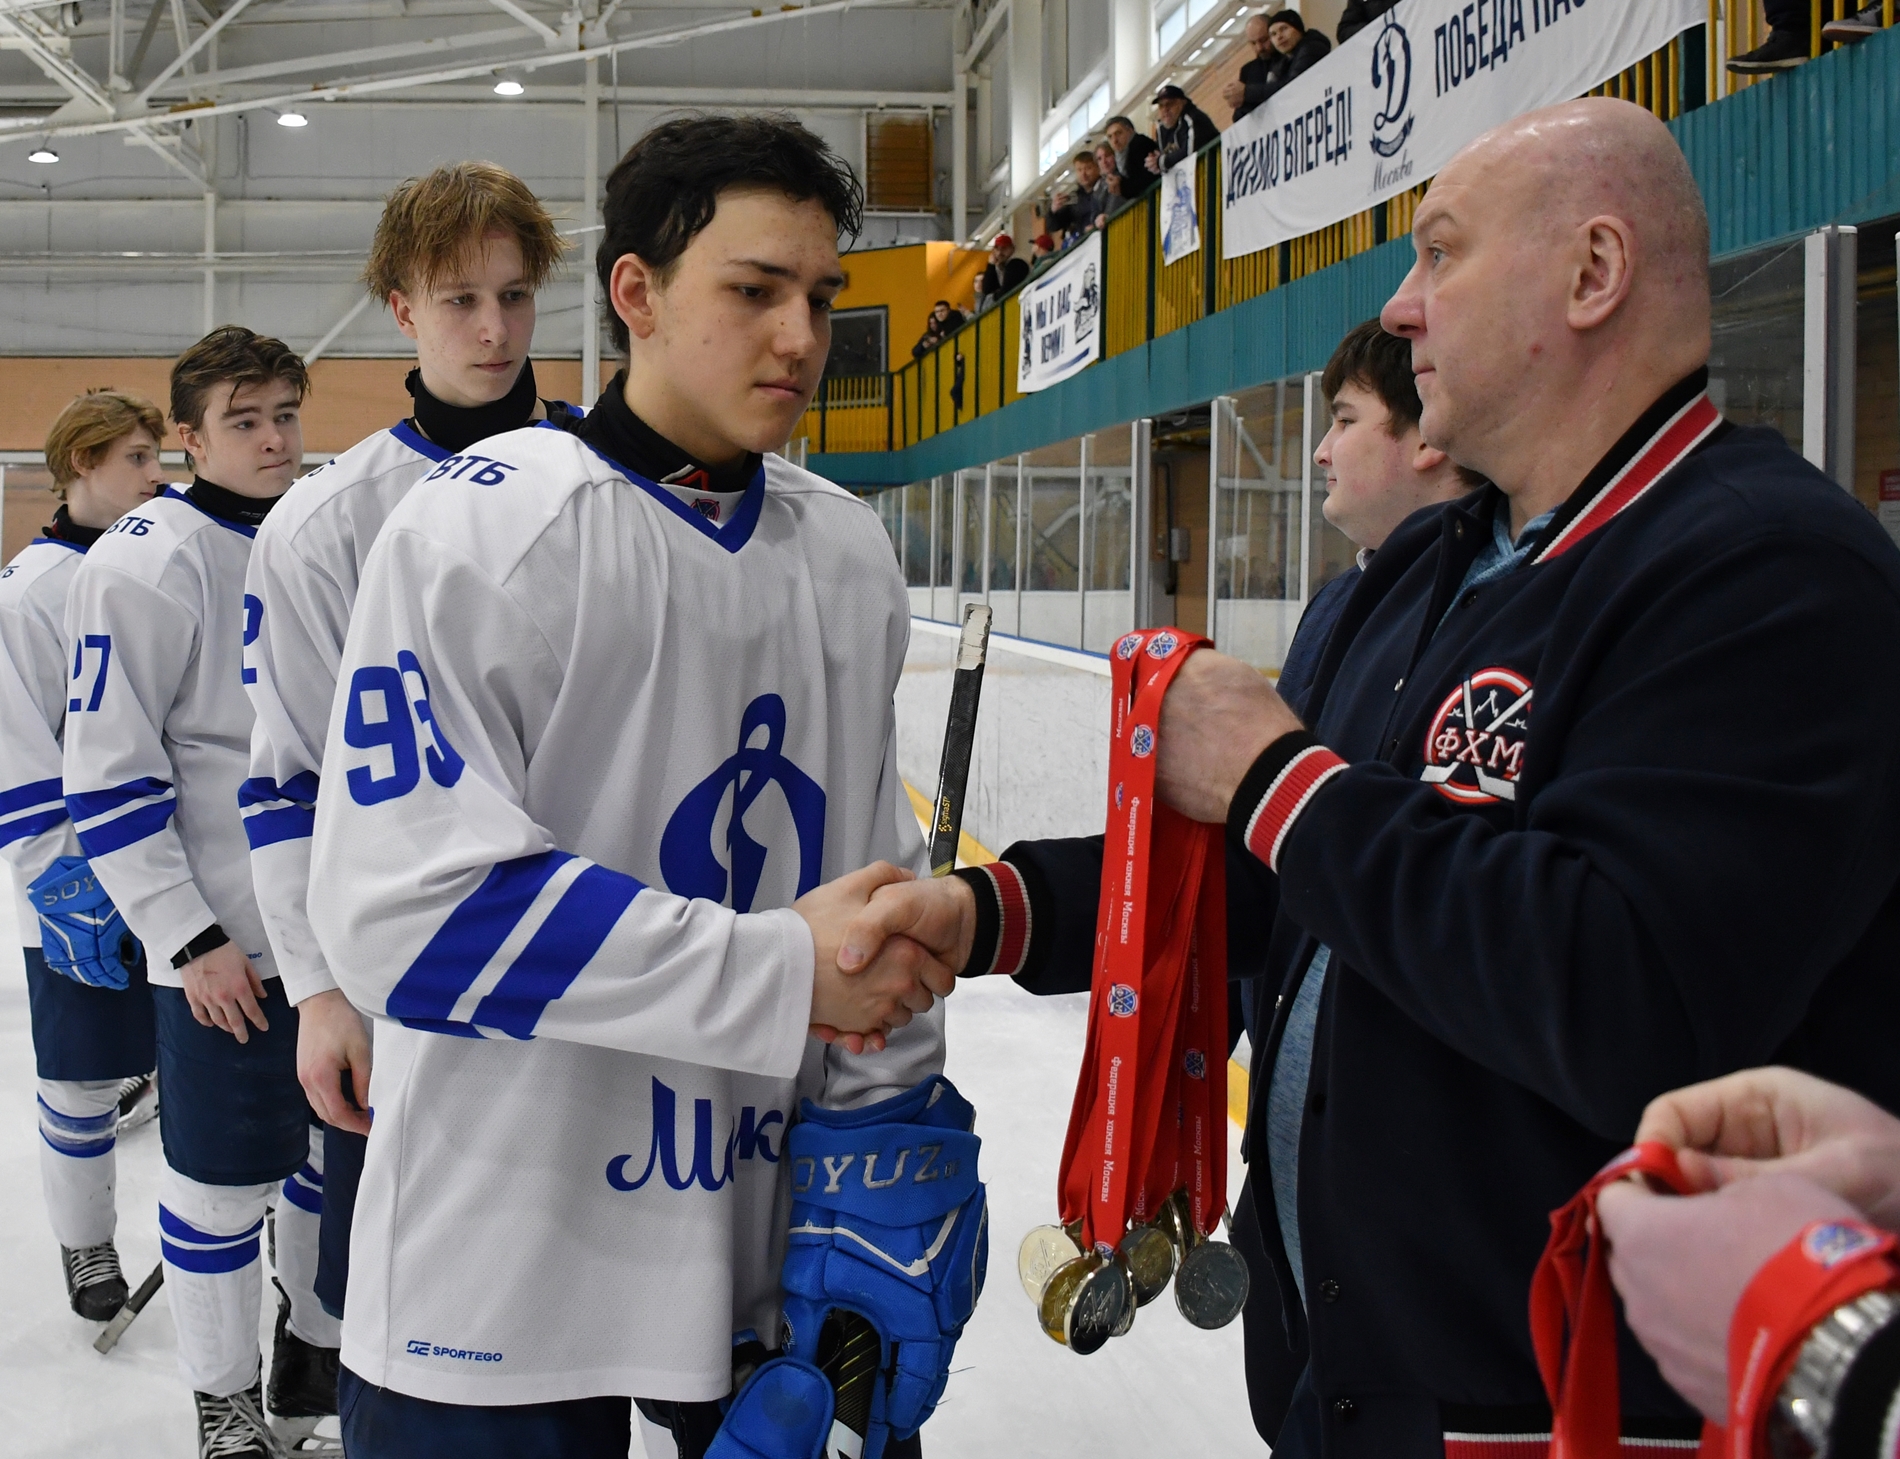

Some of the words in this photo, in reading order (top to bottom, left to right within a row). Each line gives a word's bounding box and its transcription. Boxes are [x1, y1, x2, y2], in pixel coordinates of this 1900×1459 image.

[1434, 0, 1525, 98] ПОБЕДА
[1283, 86, 1353, 183] ВПЕРЁД!
[423, 455, 519, 486] ВТБ
[1435, 726, 1526, 774] ФХМ
[1128, 796, 1140, 856] Федерация
[44, 874, 96, 906] SOY
[1124, 860, 1133, 896] хоккея
[1120, 901, 1133, 944] Москвы
[1107, 1056, 1122, 1115] Федерация
[1104, 1119, 1115, 1156] хоккея
[791, 1141, 944, 1193] OYUZ
[1101, 1160, 1114, 1202] Москвы
[433, 1346, 503, 1362] SPORTEGO
